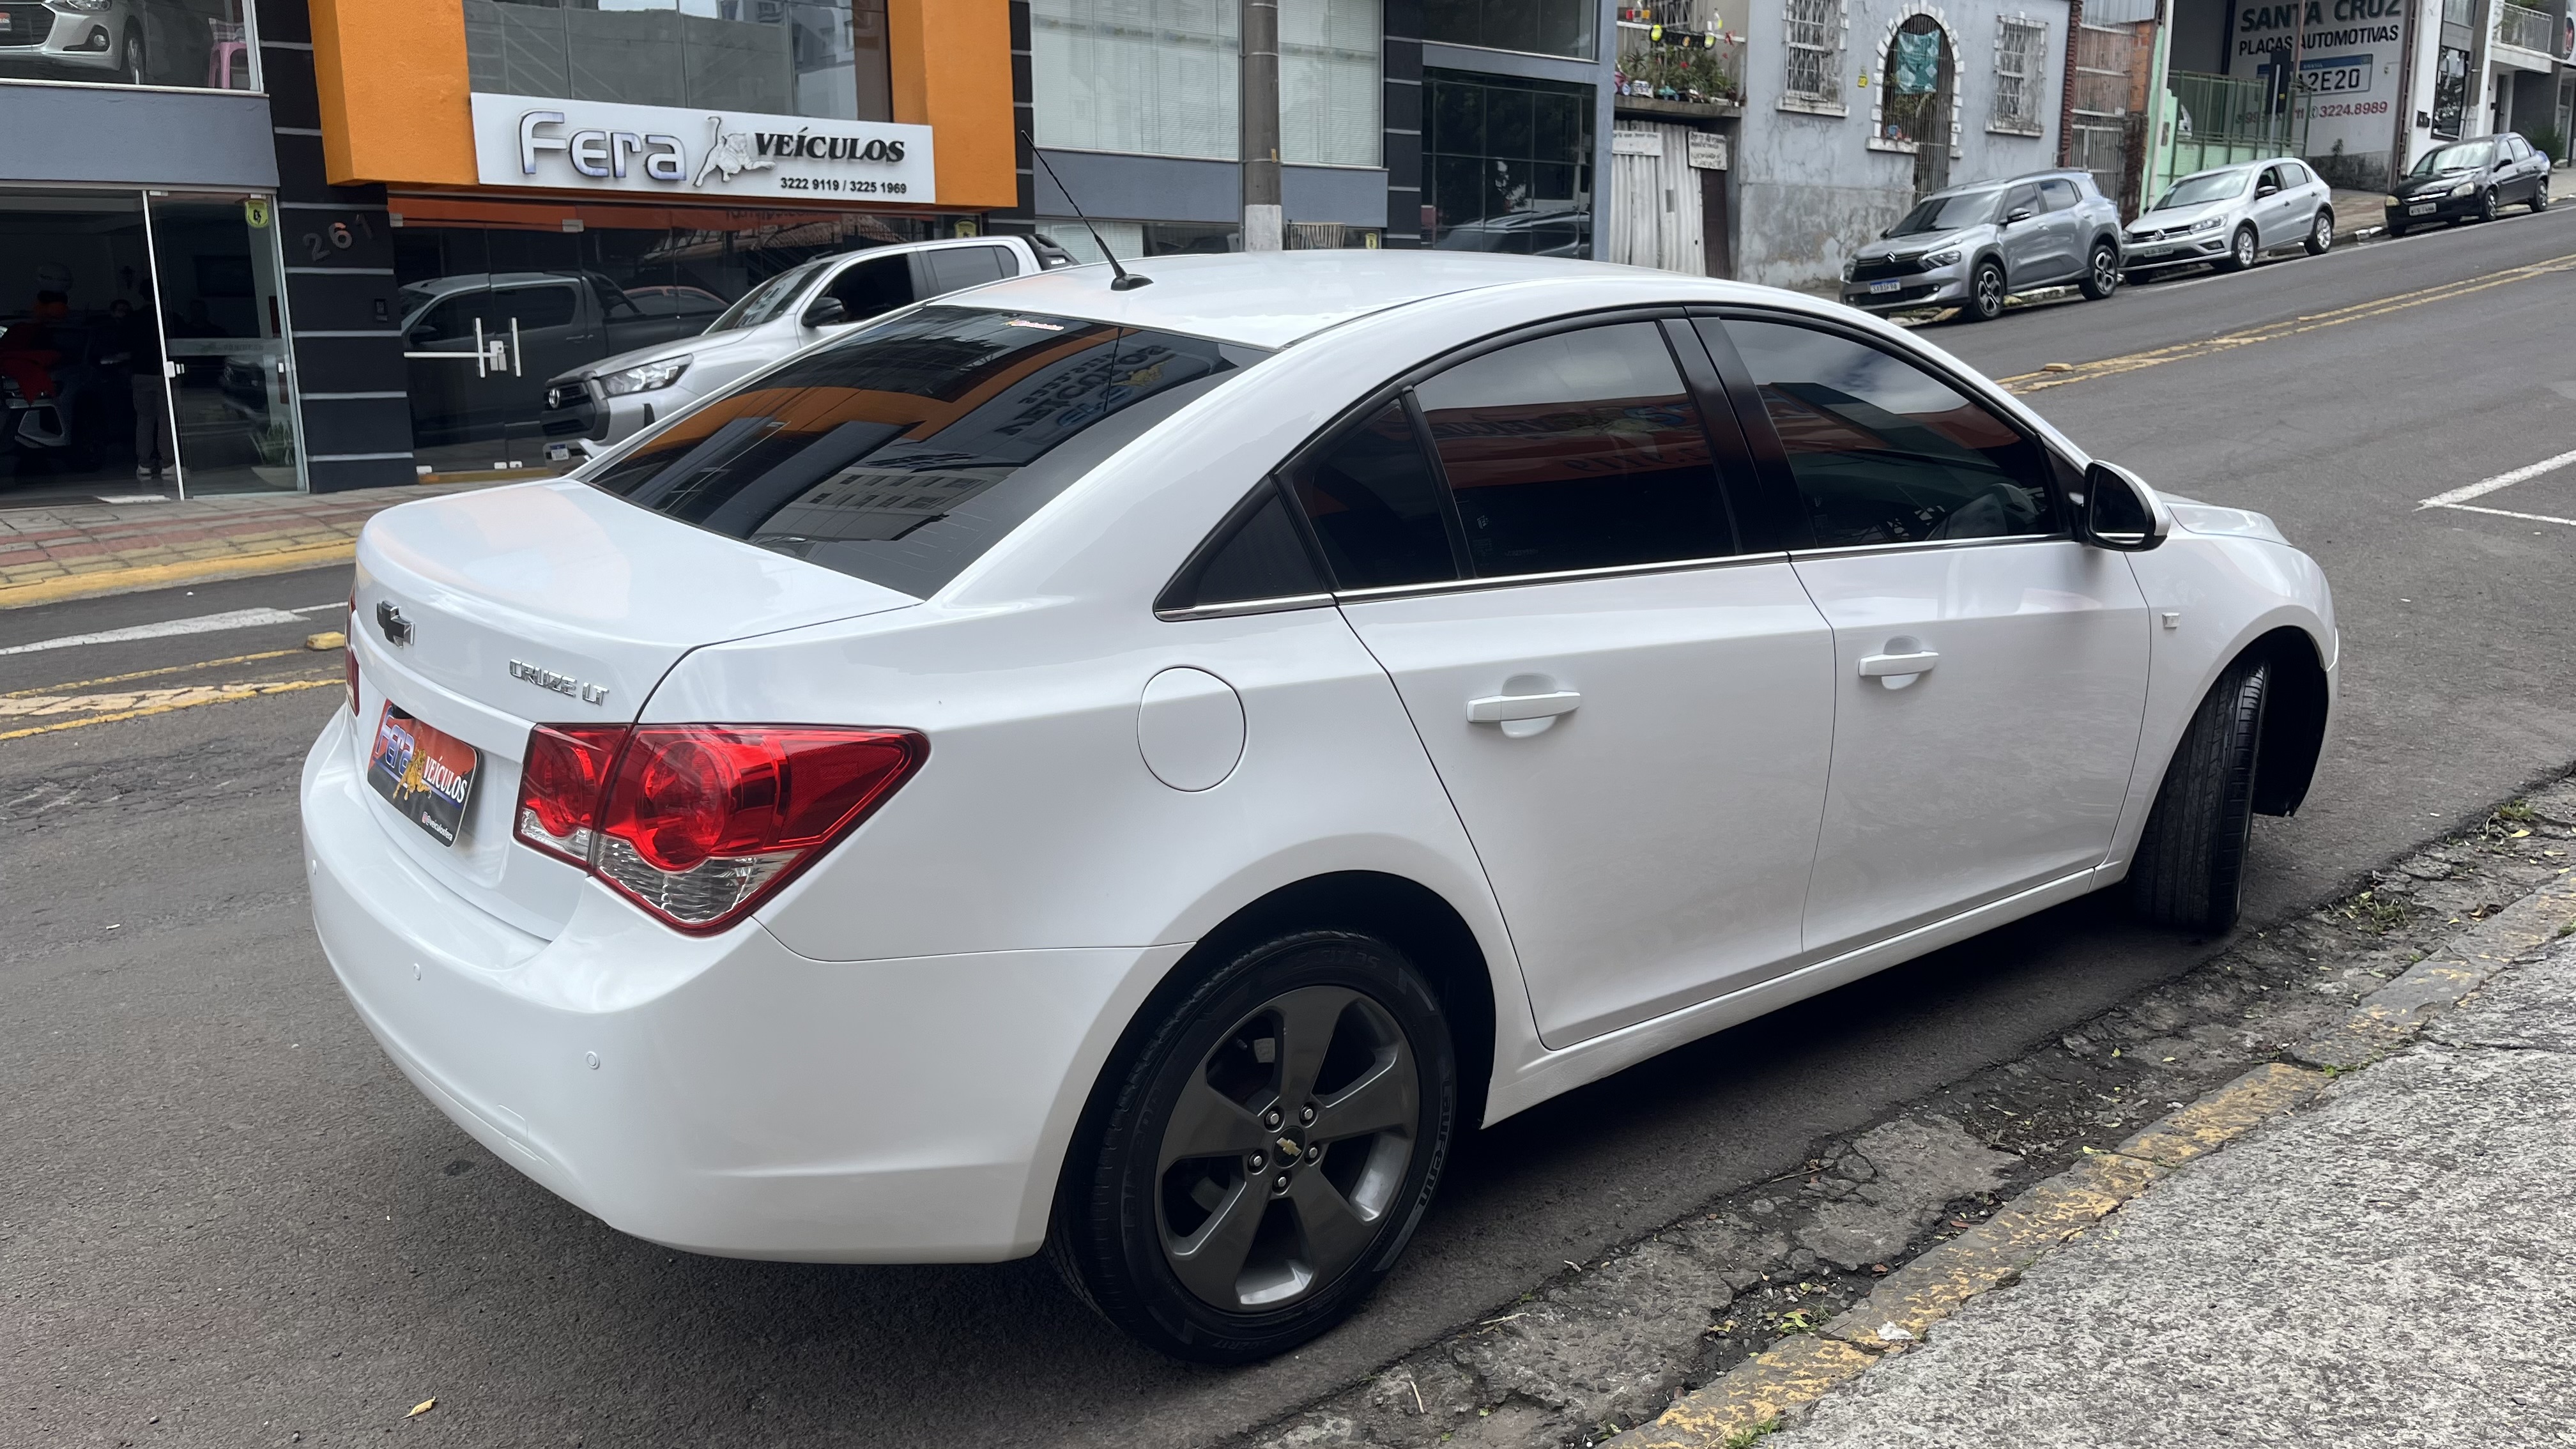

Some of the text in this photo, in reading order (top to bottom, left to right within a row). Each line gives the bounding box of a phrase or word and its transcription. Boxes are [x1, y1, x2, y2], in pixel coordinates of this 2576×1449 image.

[2334, 0, 2402, 21] CRUZ
[2239, 24, 2399, 56] PLACAS AUTOMOTIVAS
[2319, 101, 2388, 118] 3224.8989
[519, 110, 905, 181] Fera VEÍCULOS
[780, 177, 907, 194] 3222 9119 / 3225 1969
[303, 213, 372, 261] 261
[509, 659, 610, 706] CRUZE LT
[375, 705, 468, 803] Fera VEÍCULOS
